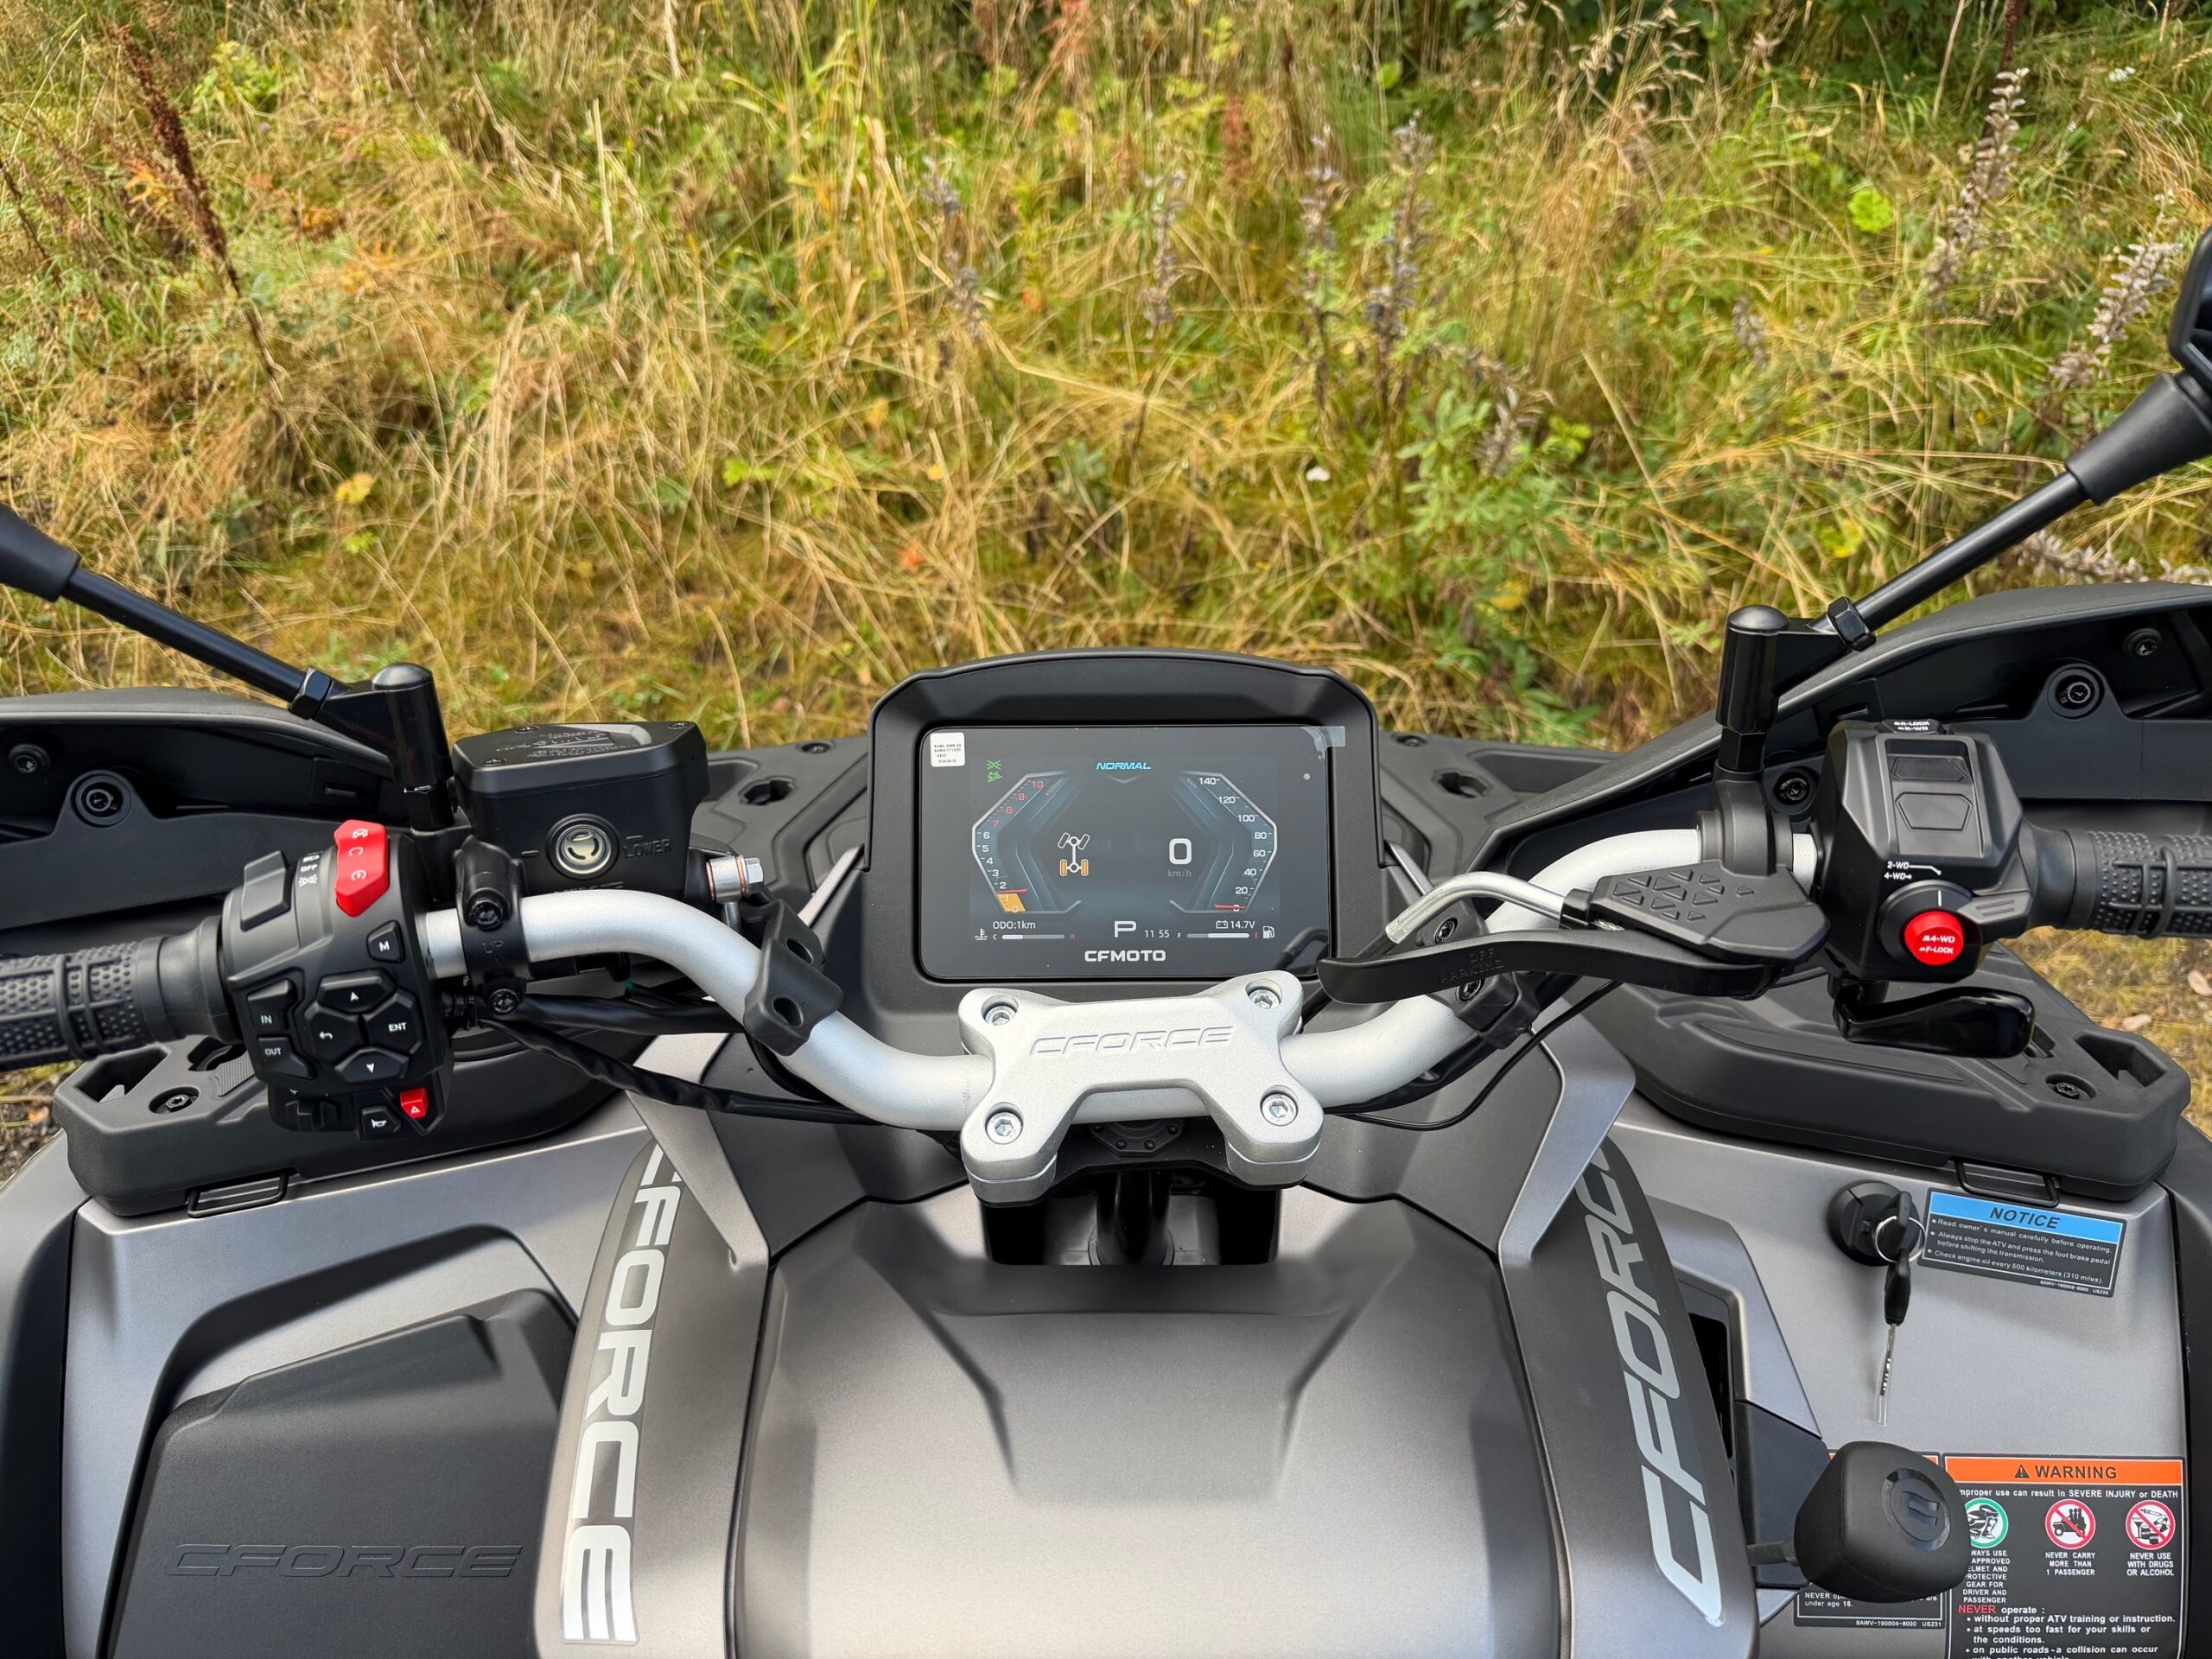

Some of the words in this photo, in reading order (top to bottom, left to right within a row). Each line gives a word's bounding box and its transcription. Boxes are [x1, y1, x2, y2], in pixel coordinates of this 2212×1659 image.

[1169, 838, 1192, 864] 0
[1887, 861, 1909, 869] 2-WD
[993, 921, 1036, 930] ODO:1km
[1114, 921, 1136, 938] P
[378, 941, 391, 951] M
[1084, 950, 1166, 962] CFMOTO
[261, 1014, 272, 1024] IN
[389, 1022, 407, 1032] ENT
[1030, 1026, 1234, 1058] CFORCE
[264, 1047, 282, 1056] OUT
[1990, 1207, 2060, 1229] NOTICE
[1937, 1218, 1956, 1227] Read
[1990, 1228, 2017, 1237] manual
[2018, 1233, 2049, 1243] carefully
[2051, 1237, 2075, 1247] before
[2076, 1243, 2112, 1254] operating.
[1937, 1239, 1959, 1249] before
[1961, 1243, 1986, 1254] shifting
[1999, 1249, 2044, 1262] transmission.
[1938, 1231, 1963, 1241] Always
[1964, 1236, 1979, 1244] stop
[2022, 1245, 2041, 1254] press
[2069, 1253, 2089, 1262] brake
[2090, 1256, 2110, 1265] pedal
[1935, 1250, 1956, 1259] Check
[1957, 1254, 1980, 1263] engine
[1991, 1260, 2011, 1268] every
[2026, 1265, 2062, 1277] kilometers
[1573, 1147, 1721, 1614] CFORC
[2035, 1465, 2117, 1478] WARNING
[1960, 1489, 1992, 1497] mproper
[1958, 1605, 1996, 1614] NEVER
[2069, 1614, 2106, 1624] training
[2123, 1614, 2175, 1623] instruction.
[1987, 1625, 2021, 1634] speeds
[2086, 1626, 2107, 1635] your
[1989, 1646, 2018, 1655] public
